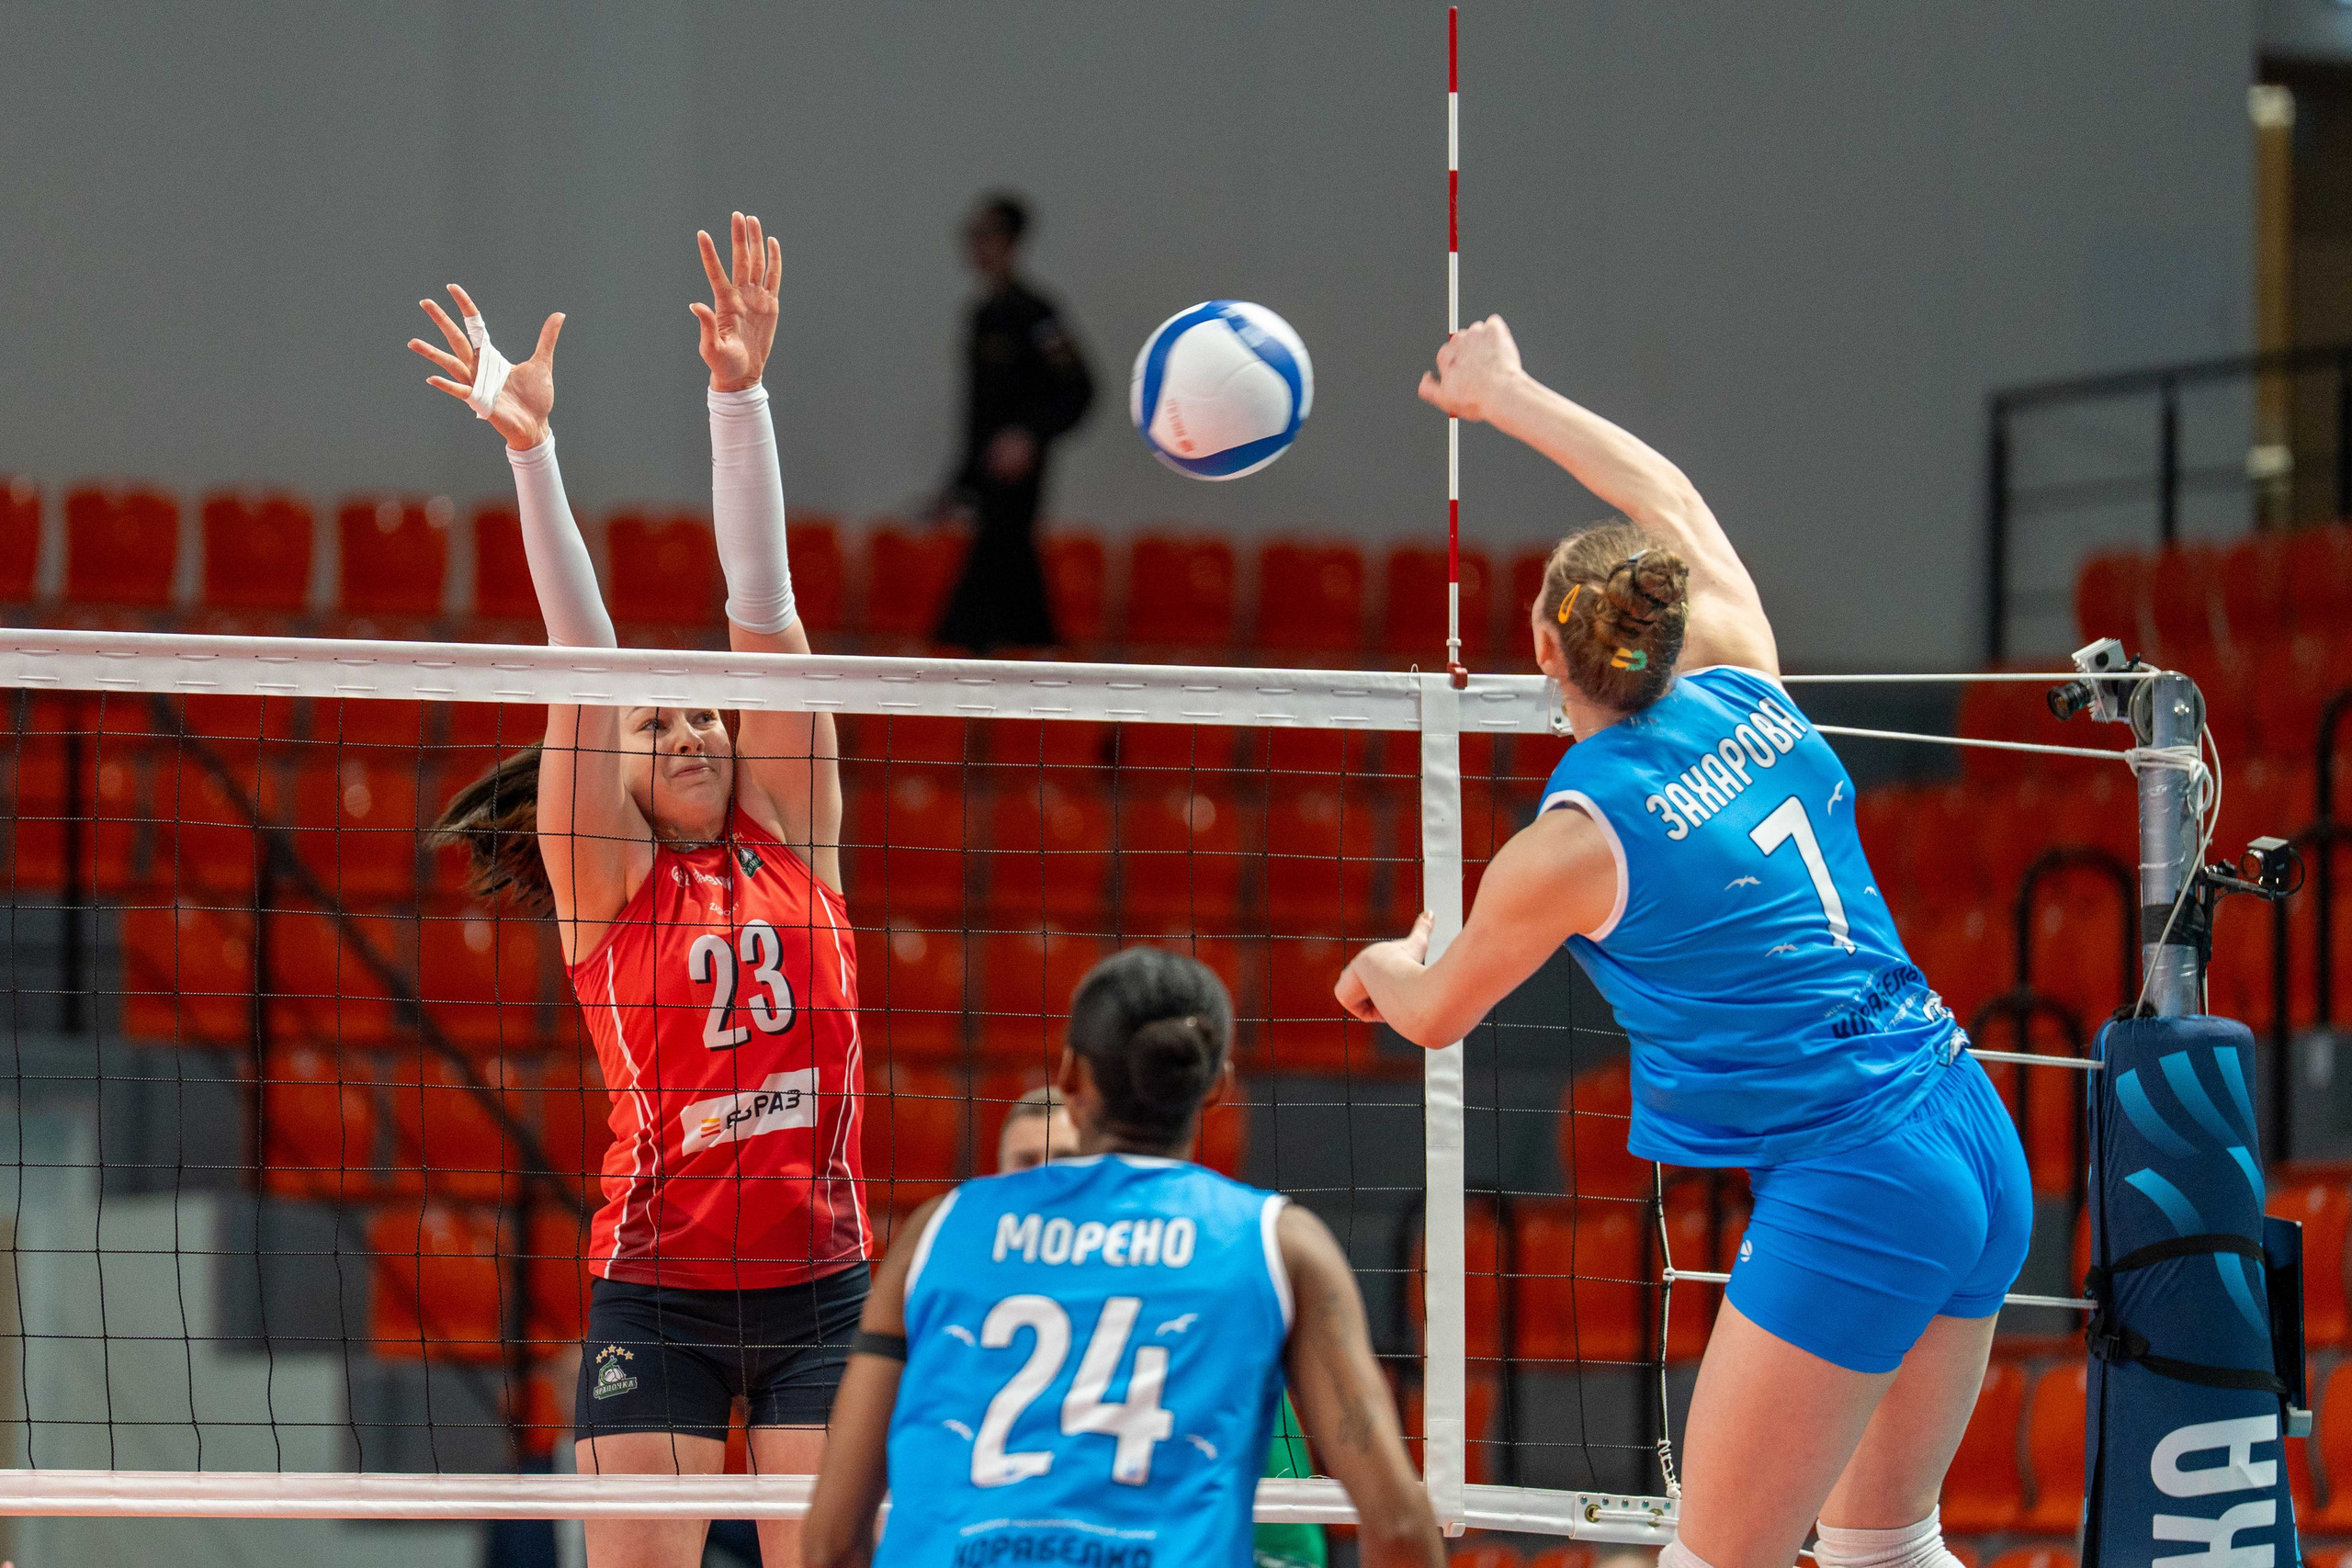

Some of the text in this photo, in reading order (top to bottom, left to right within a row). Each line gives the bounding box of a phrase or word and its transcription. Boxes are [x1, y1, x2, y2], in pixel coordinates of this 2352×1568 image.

[1645, 696, 1808, 841] ЗАХАРОВА
[1748, 794, 1857, 955] 7
[689, 919, 796, 1051] 23
[992, 1212, 1197, 1269] МОРЕНО
[970, 1293, 1174, 1488] 24
